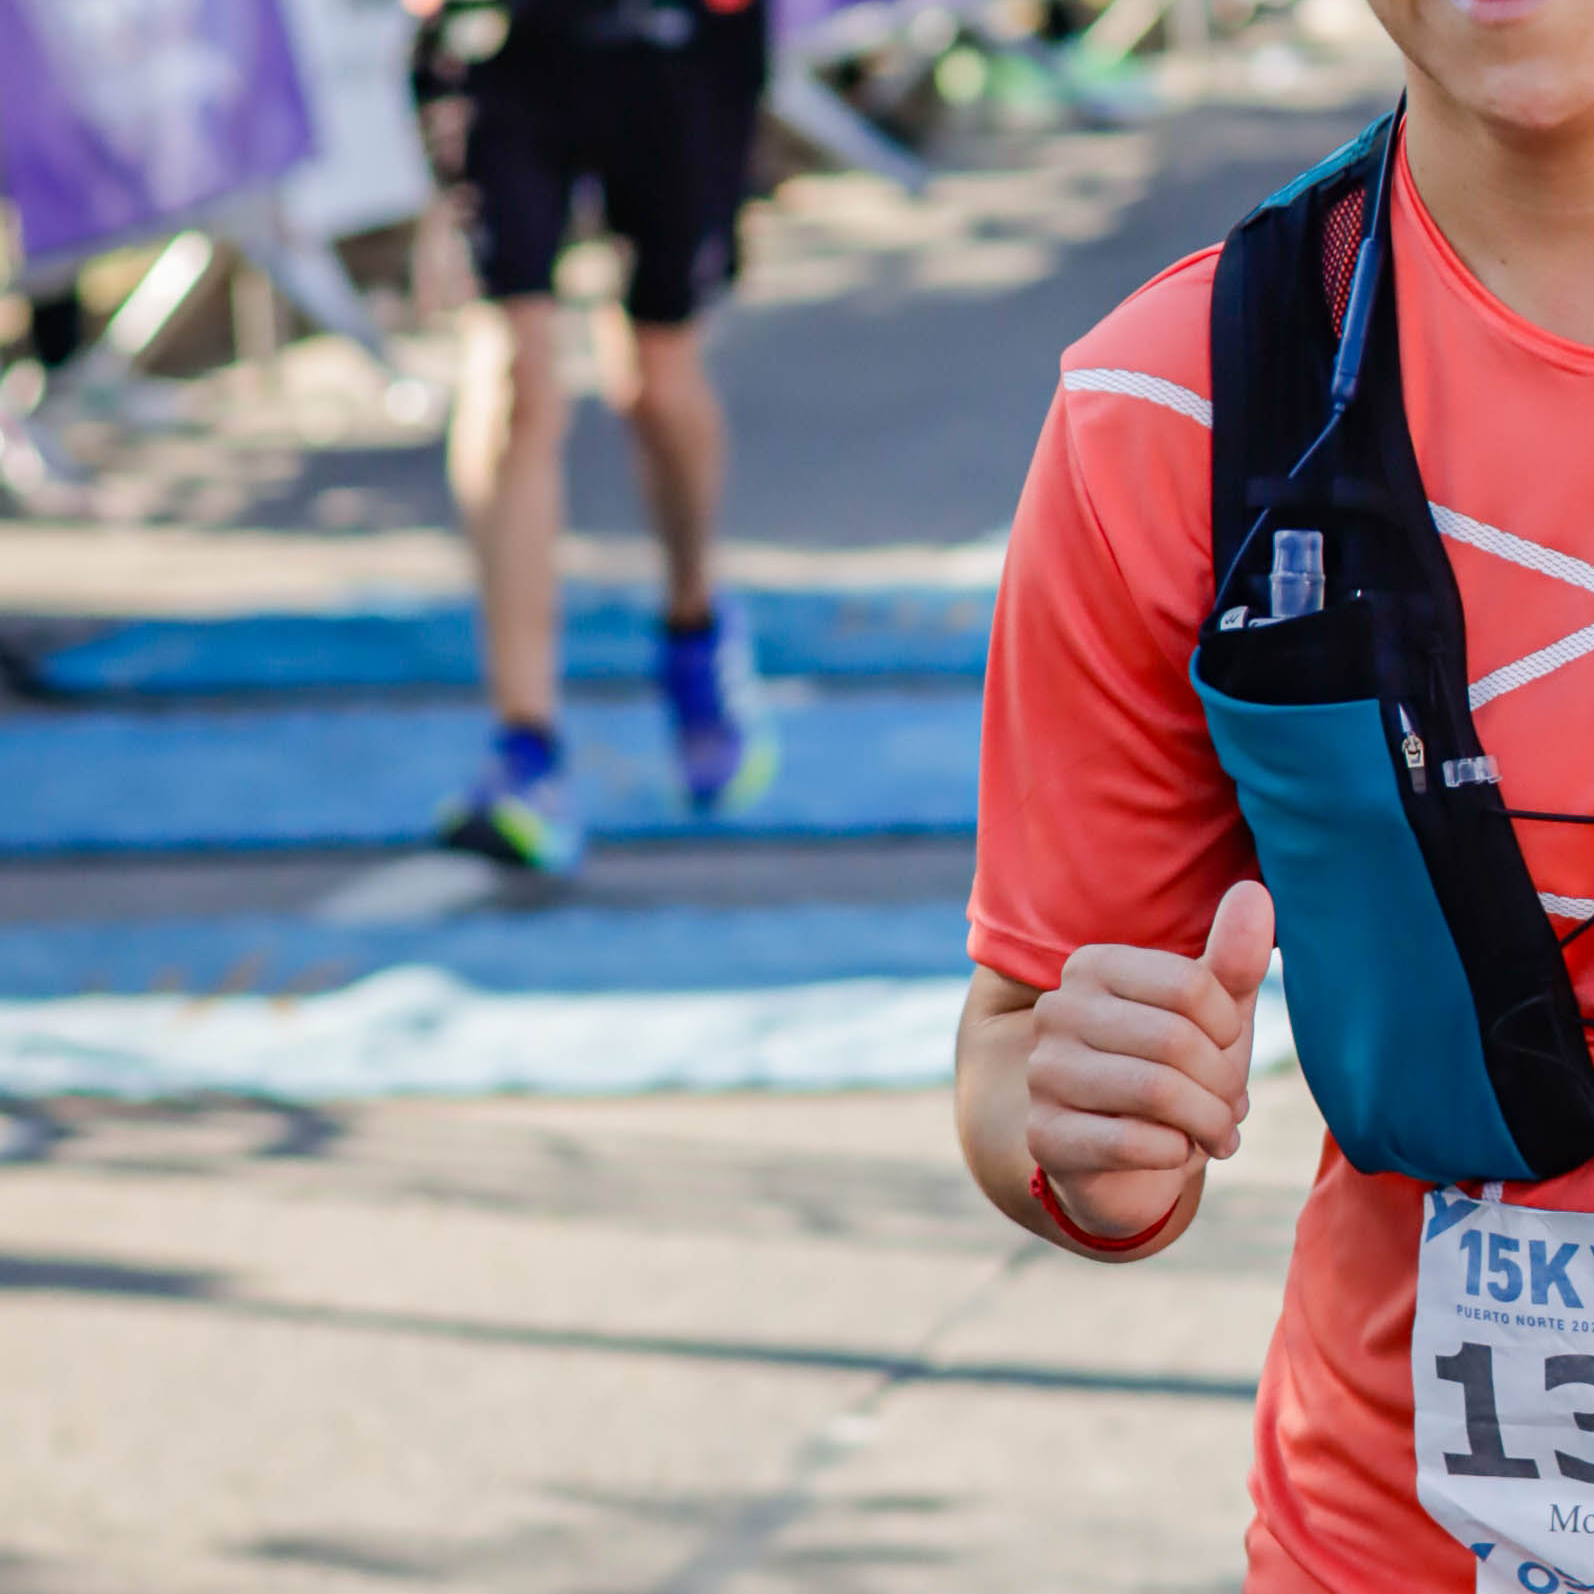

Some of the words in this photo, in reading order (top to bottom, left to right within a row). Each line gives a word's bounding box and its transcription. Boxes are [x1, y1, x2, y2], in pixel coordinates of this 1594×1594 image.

[1459, 1229, 1585, 1309] 15K
[1456, 1305, 1510, 1325] PUERTO
[1516, 1315, 1565, 1331] NORTE
